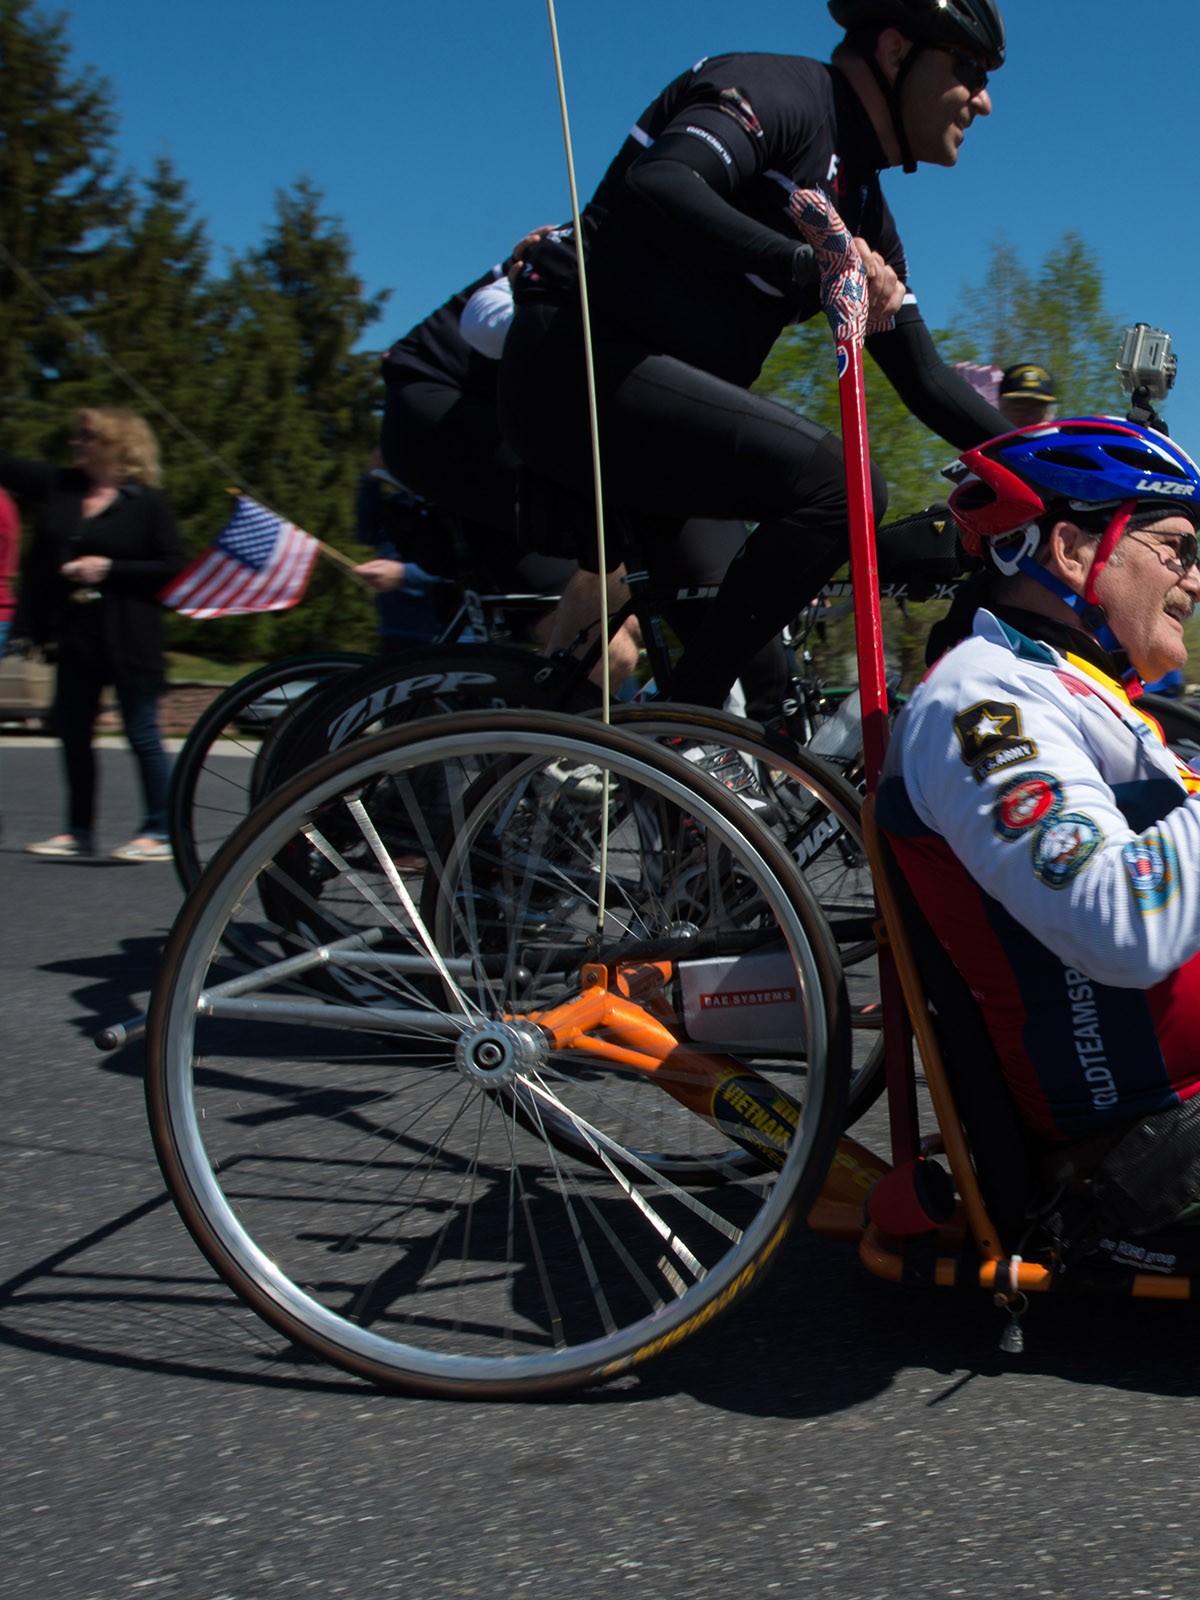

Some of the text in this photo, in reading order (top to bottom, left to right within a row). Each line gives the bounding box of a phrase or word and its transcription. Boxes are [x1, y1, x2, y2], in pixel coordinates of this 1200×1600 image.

[1135, 481, 1196, 496] LAZER
[703, 990, 793, 1007] BAE SYSTEMS
[720, 1081, 792, 1151] VIETNAM
